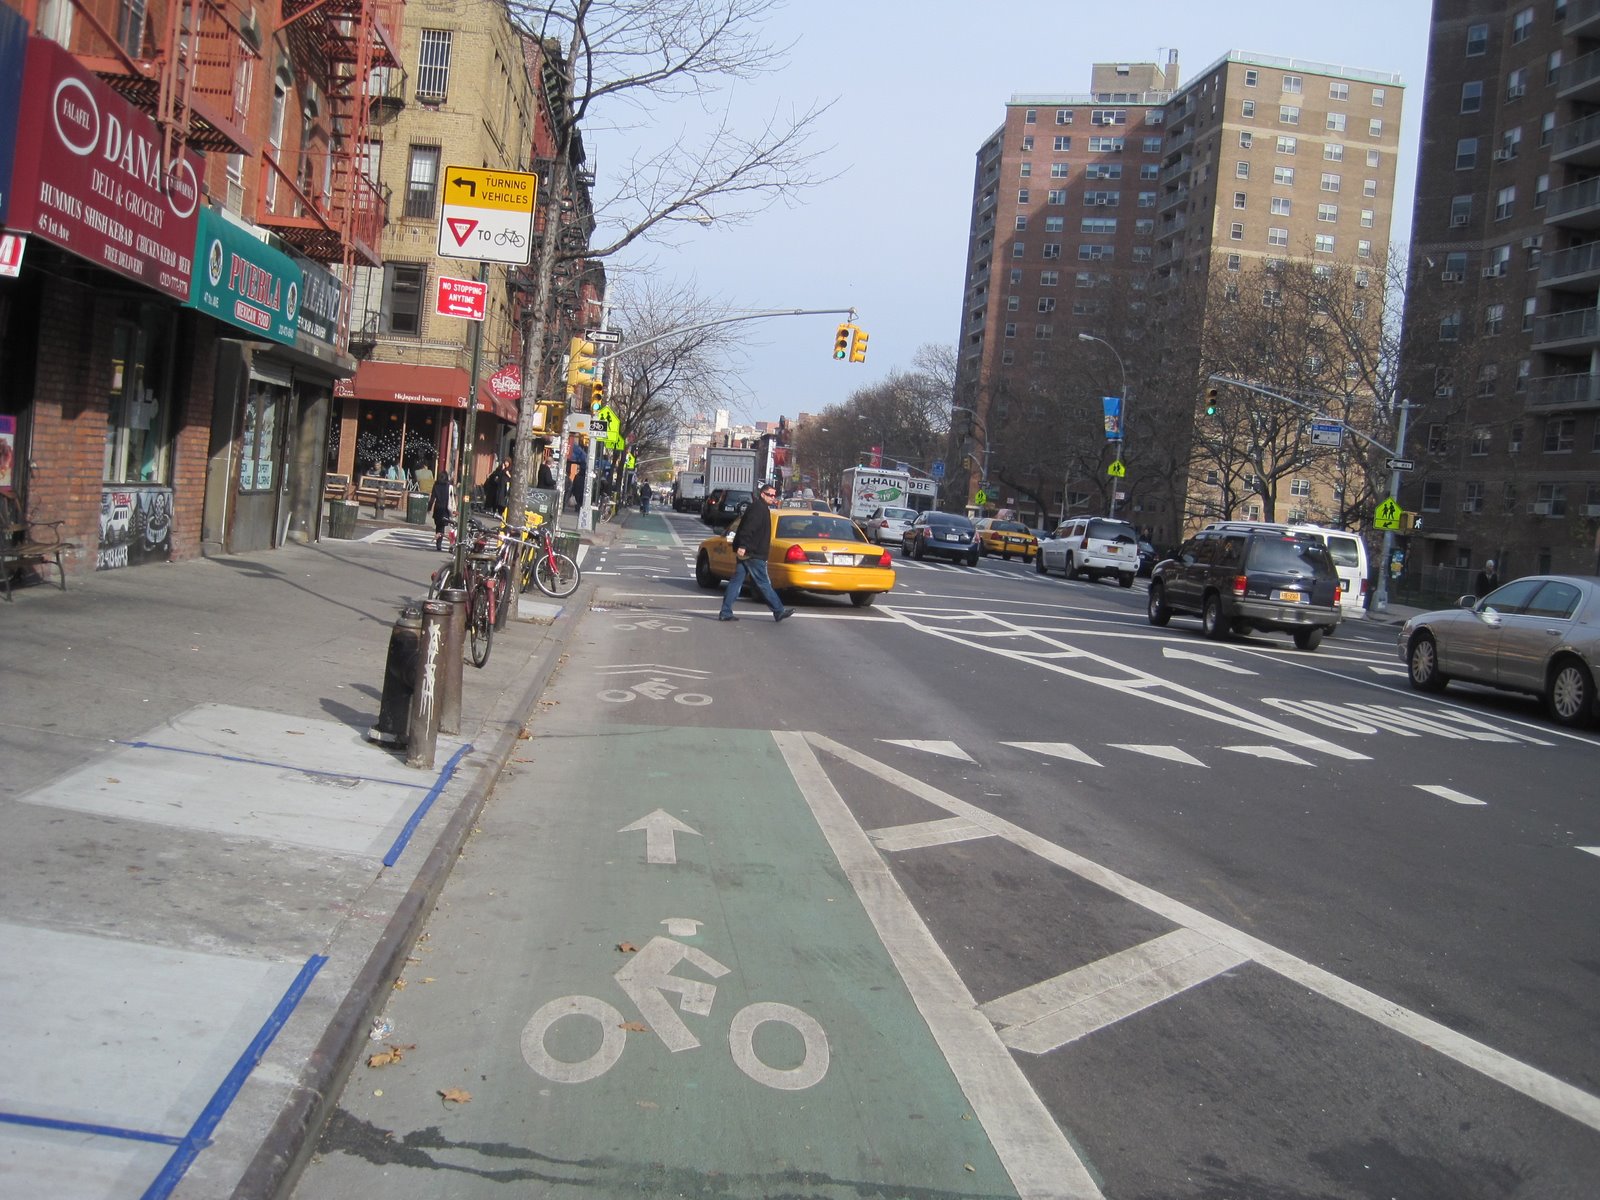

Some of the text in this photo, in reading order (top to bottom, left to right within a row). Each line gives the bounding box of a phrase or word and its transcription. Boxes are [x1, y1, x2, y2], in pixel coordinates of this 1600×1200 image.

[62, 98, 91, 131] FALAFEL
[103, 112, 162, 193] DANA
[486, 177, 527, 190] TURNING
[91, 168, 166, 230] DELI & GROCERY
[481, 191, 529, 205] VEHICLES
[38, 212, 71, 242] 45 1st Ave
[40, 181, 191, 276] HUMMUS SHISH KEBAB CHICKEN KEBAB BEER
[477, 229, 492, 241] TO
[103, 244, 144, 275] FREE DELIVERY
[228, 252, 282, 312] PUEBLA
[442, 282, 483, 296] NO STOPPING
[448, 293, 475, 305] ANYTIME
[236, 302, 270, 328] MEXICAN FOOD
[394, 392, 421, 403] Highspeed
[421, 394, 443, 404] Internet
[860, 477, 903, 490] U-HAUL
[1260, 697, 1558, 746] ONLY
